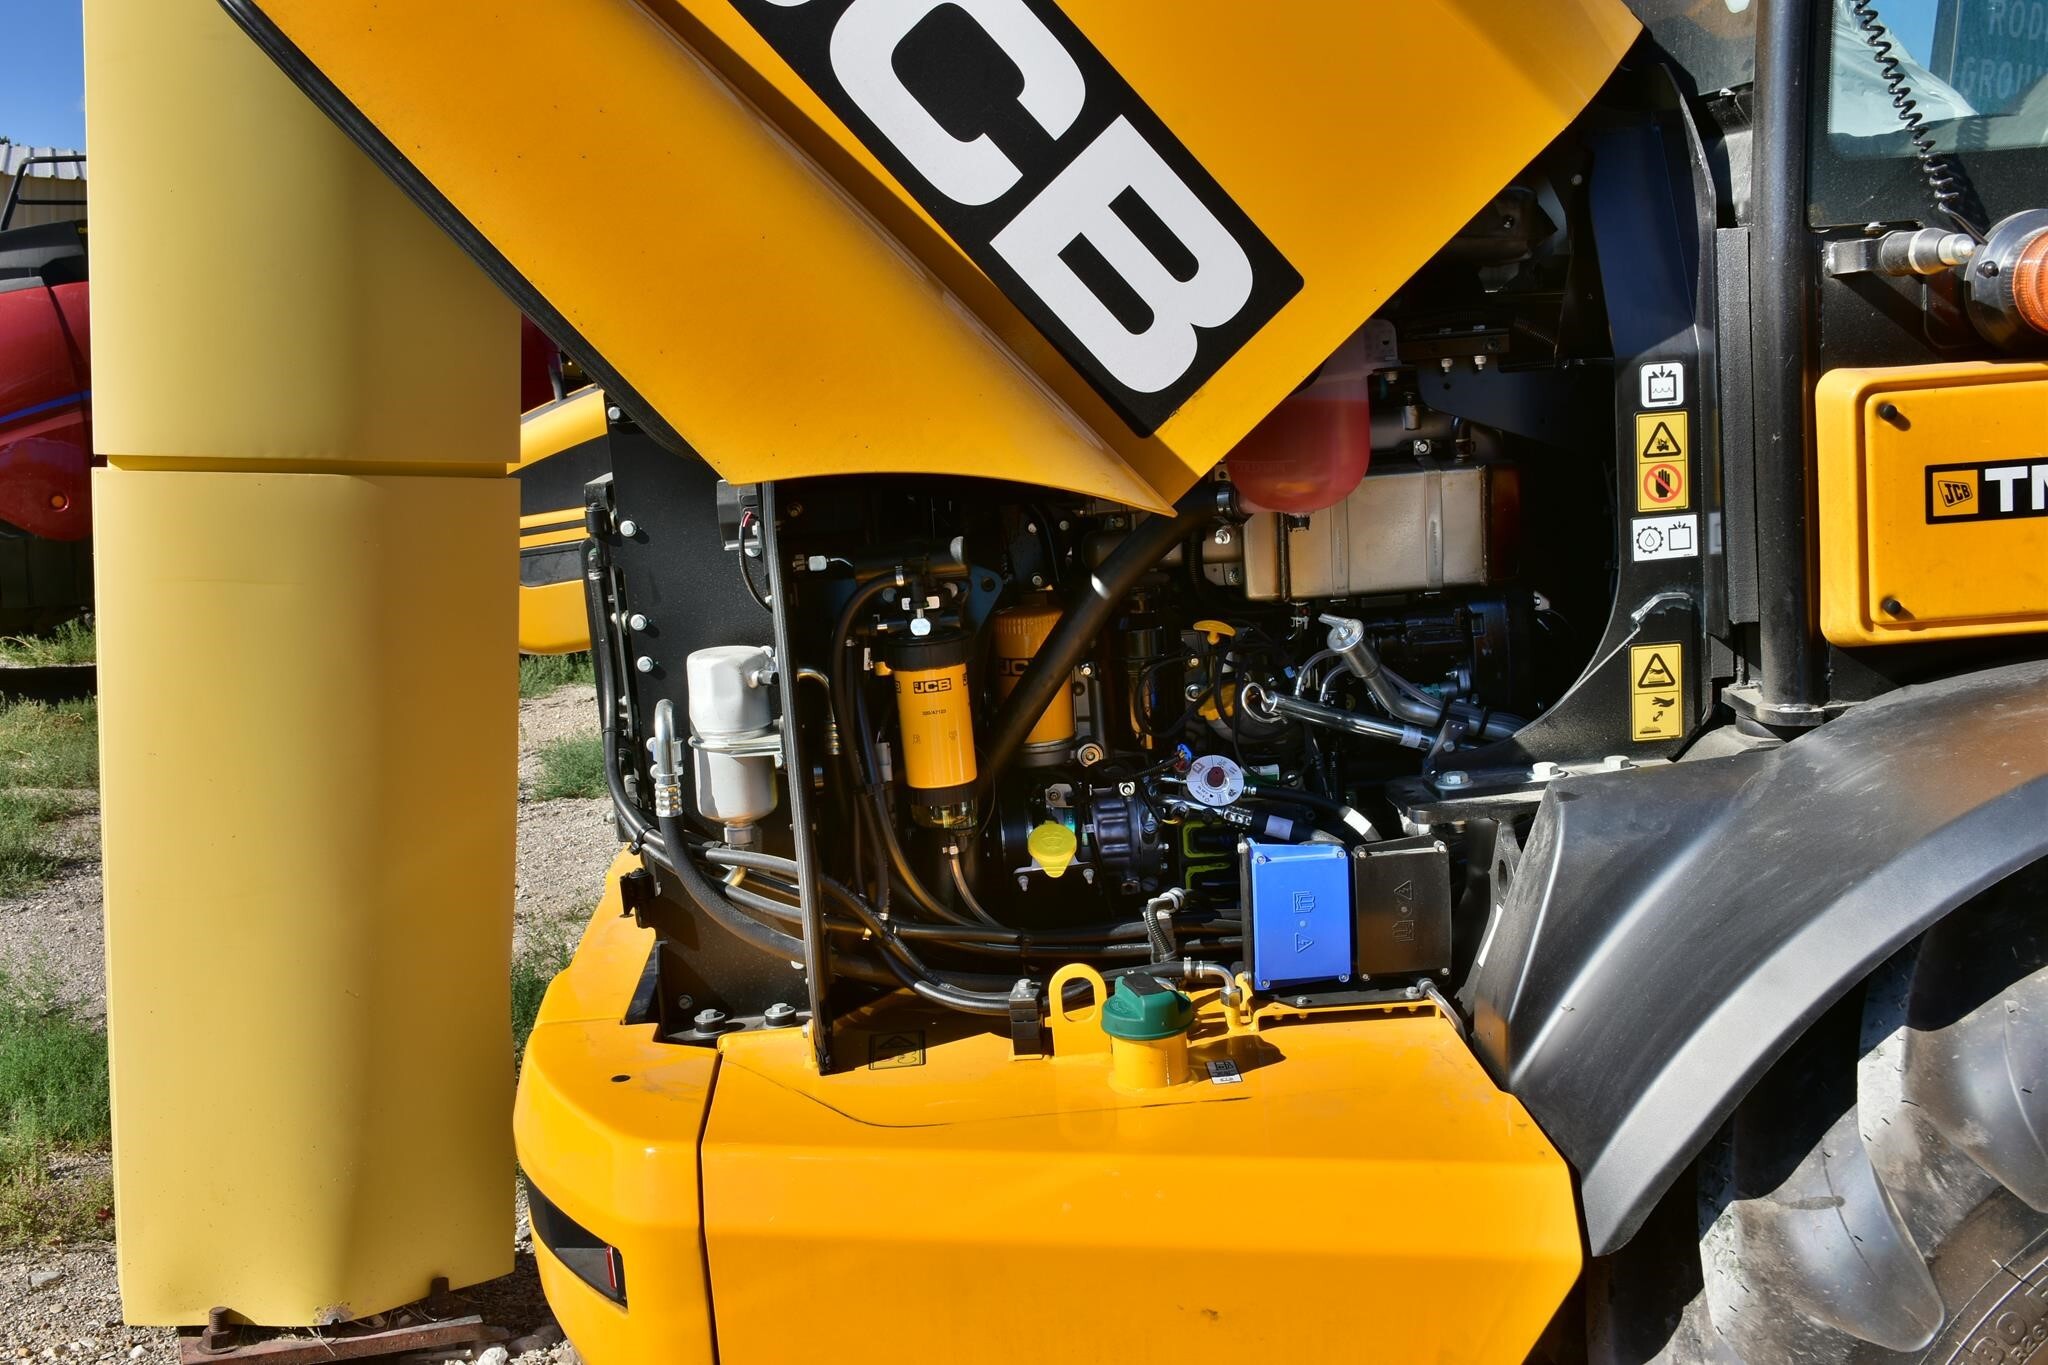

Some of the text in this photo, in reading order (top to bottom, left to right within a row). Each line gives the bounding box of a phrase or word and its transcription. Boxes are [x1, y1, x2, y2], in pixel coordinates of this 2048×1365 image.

[1987, 0, 2048, 42] ROD
[1959, 56, 2048, 100] GROU
[764, 0, 1254, 394] CB
[1943, 482, 1971, 505] JCB
[1001, 660, 1030, 675] JC
[914, 678, 951, 693] JCB
